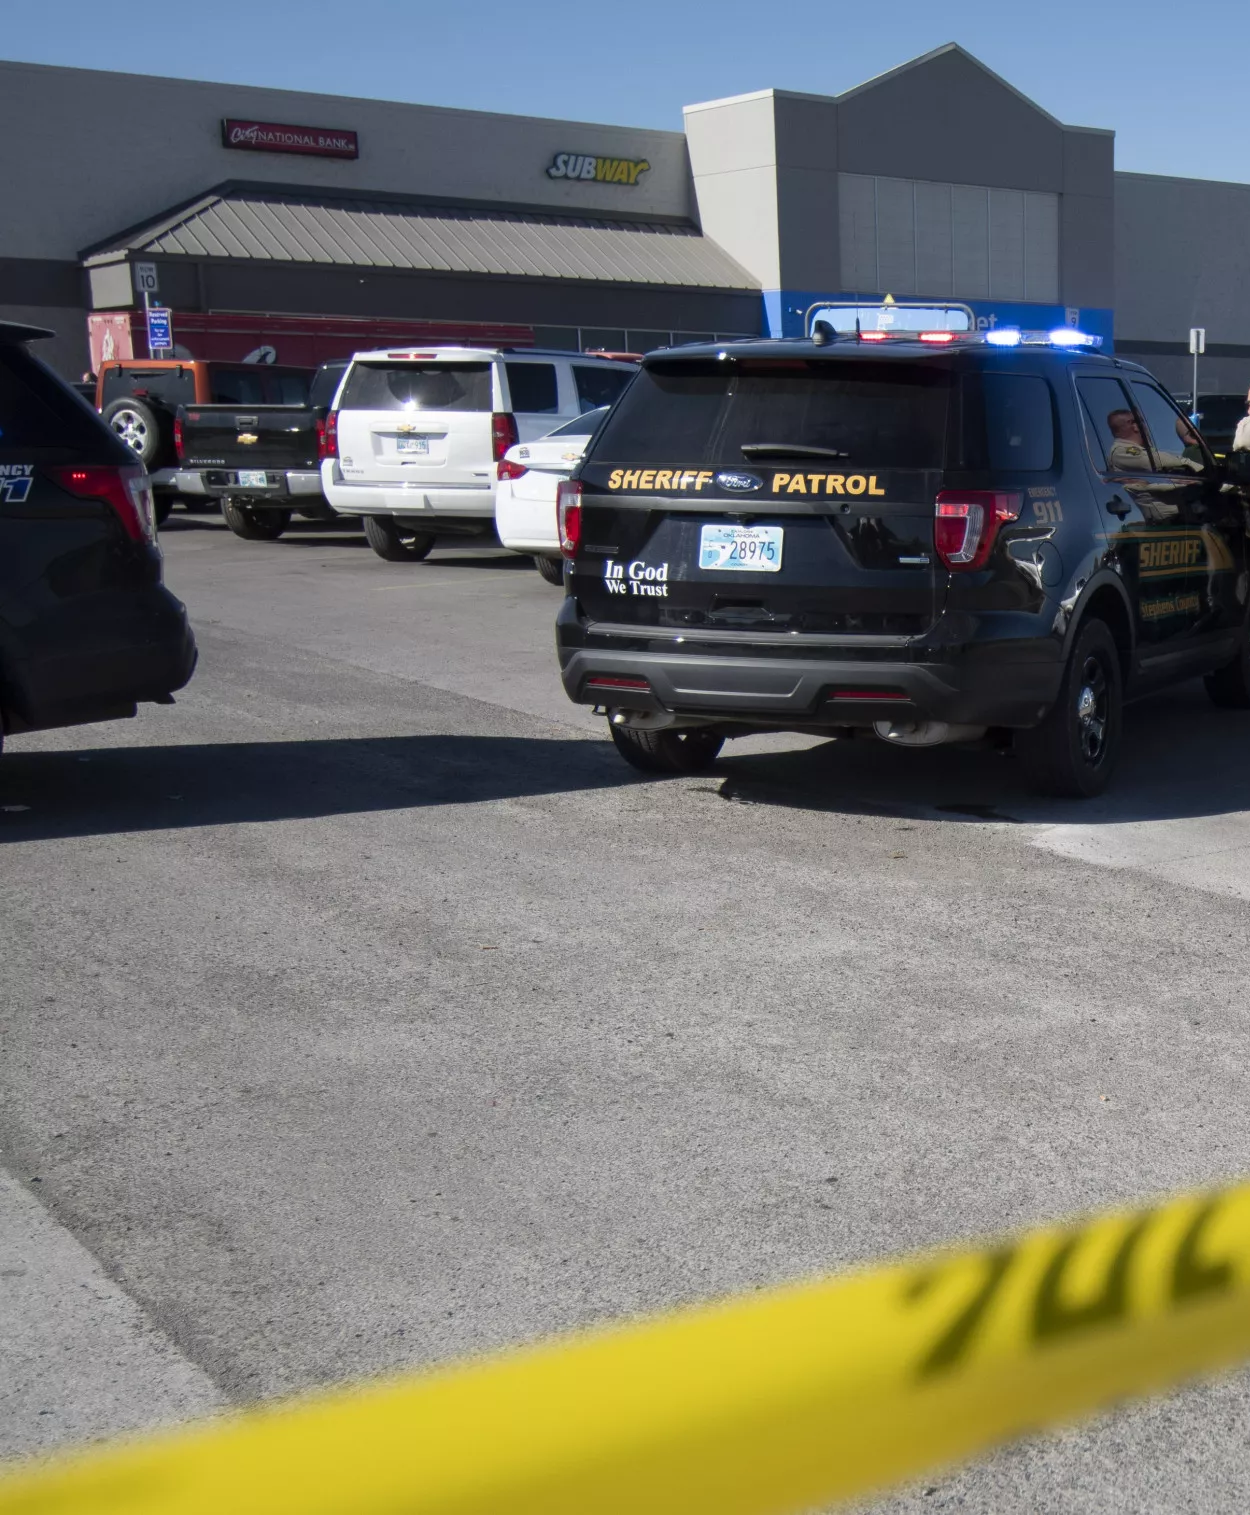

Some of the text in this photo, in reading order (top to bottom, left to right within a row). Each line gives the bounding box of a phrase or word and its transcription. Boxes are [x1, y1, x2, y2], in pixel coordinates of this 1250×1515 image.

[231, 126, 348, 149] City NATIONAL BANK
[548, 153, 650, 185] SUBWAY
[141, 275, 155, 288] 10
[607, 469, 885, 496] SHERIFF PATROL
[726, 476, 751, 488] Ford
[1033, 500, 1064, 524] 911
[729, 541, 775, 561] 28975
[1139, 540, 1200, 568] SHERIFF
[604, 560, 668, 582] In God
[605, 579, 668, 597] We Trust
